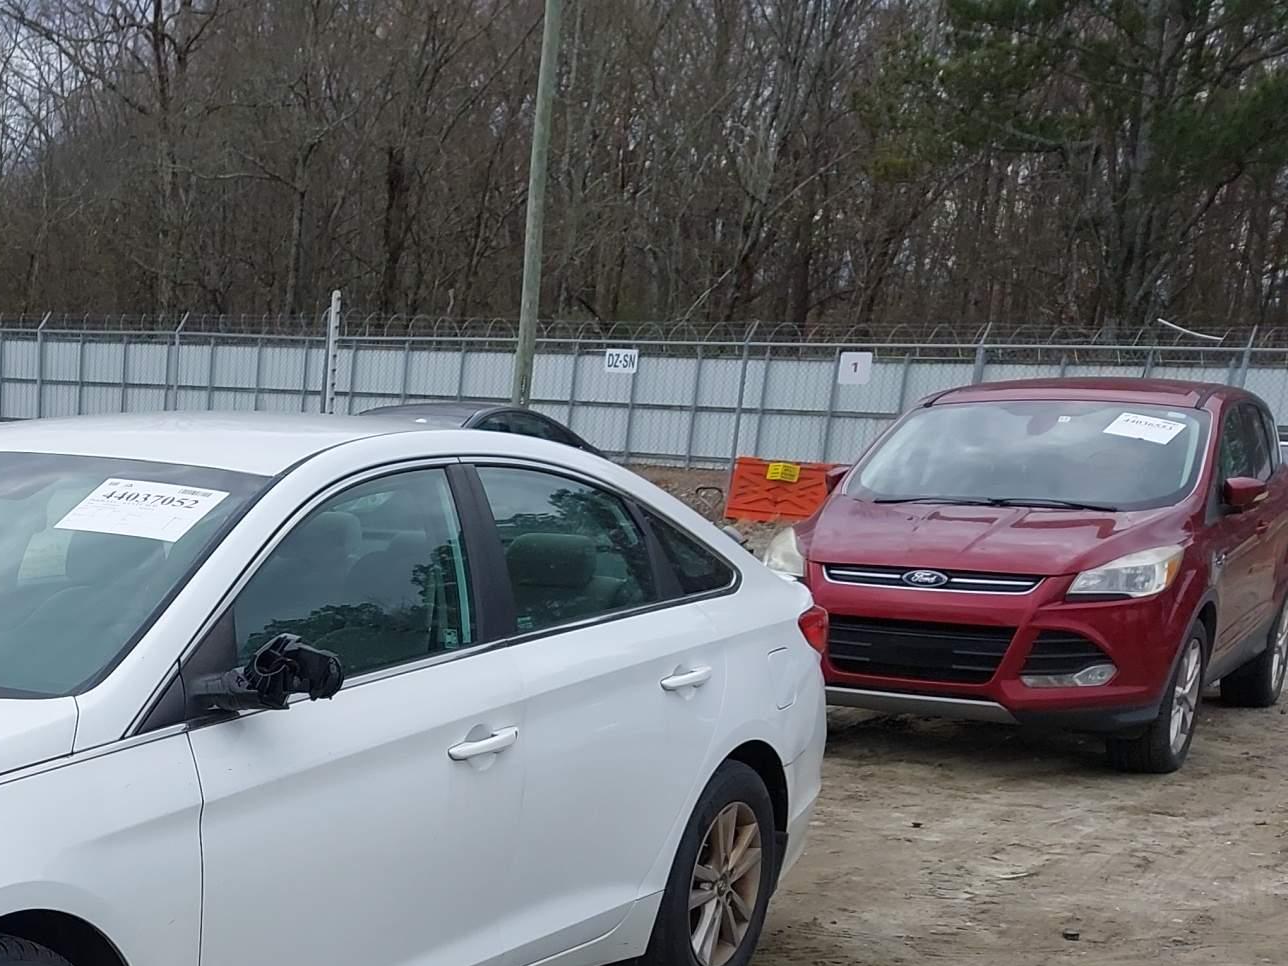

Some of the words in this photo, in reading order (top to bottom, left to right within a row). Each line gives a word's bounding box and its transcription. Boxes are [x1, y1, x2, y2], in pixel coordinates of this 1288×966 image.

[607, 353, 636, 368] DZ-SN
[851, 362, 859, 373] 1
[102, 490, 199, 508] 44037052
